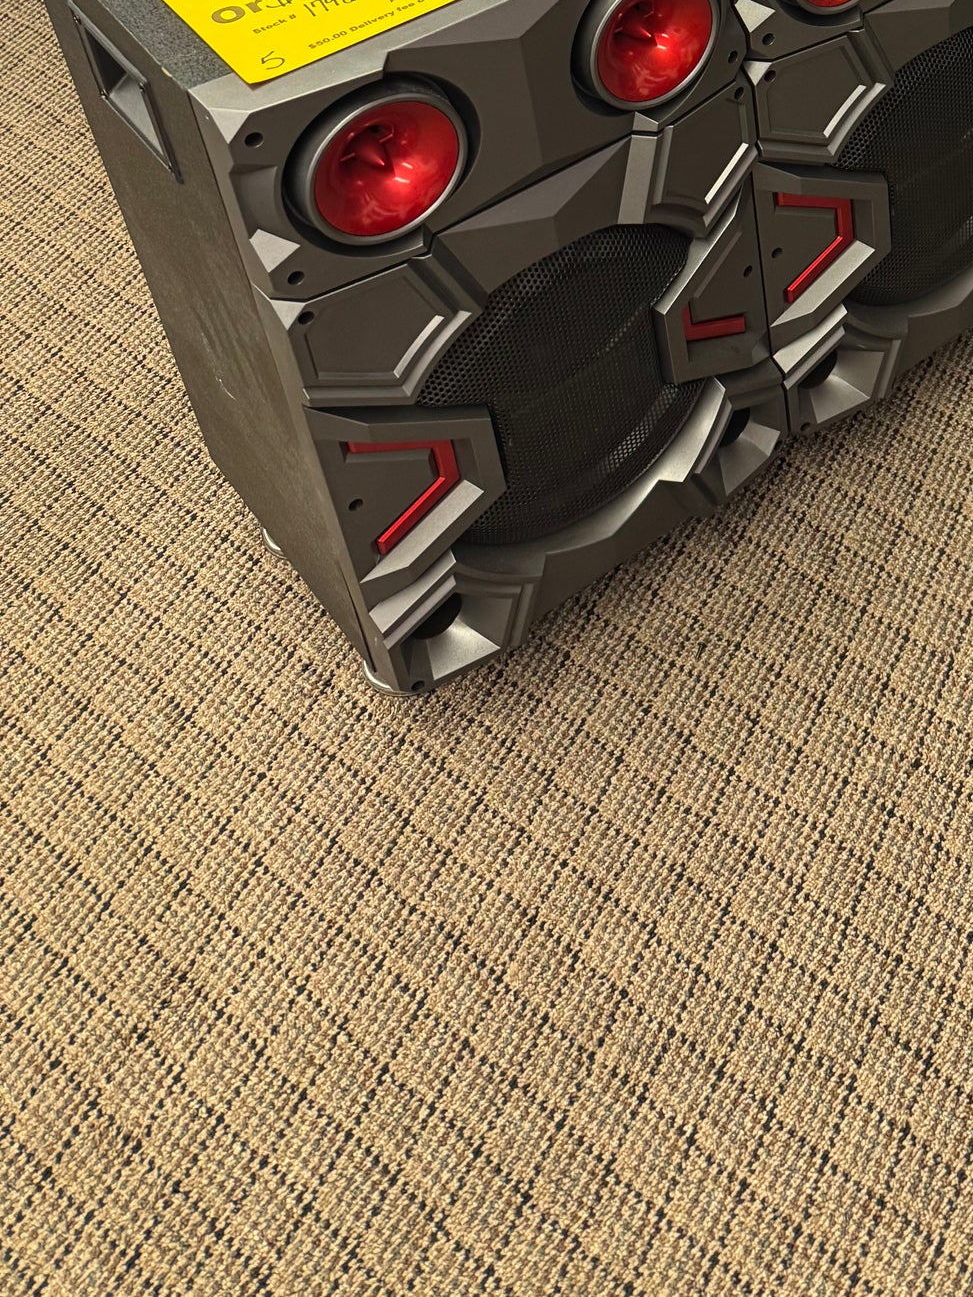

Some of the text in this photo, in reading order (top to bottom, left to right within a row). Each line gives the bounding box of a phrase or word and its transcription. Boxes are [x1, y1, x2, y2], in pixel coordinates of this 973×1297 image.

[252, 18, 287, 35] Stock
[308, 30, 347, 49] $50.00
[349, 9, 395, 33] Delivery
[396, 2, 415, 12] fee
